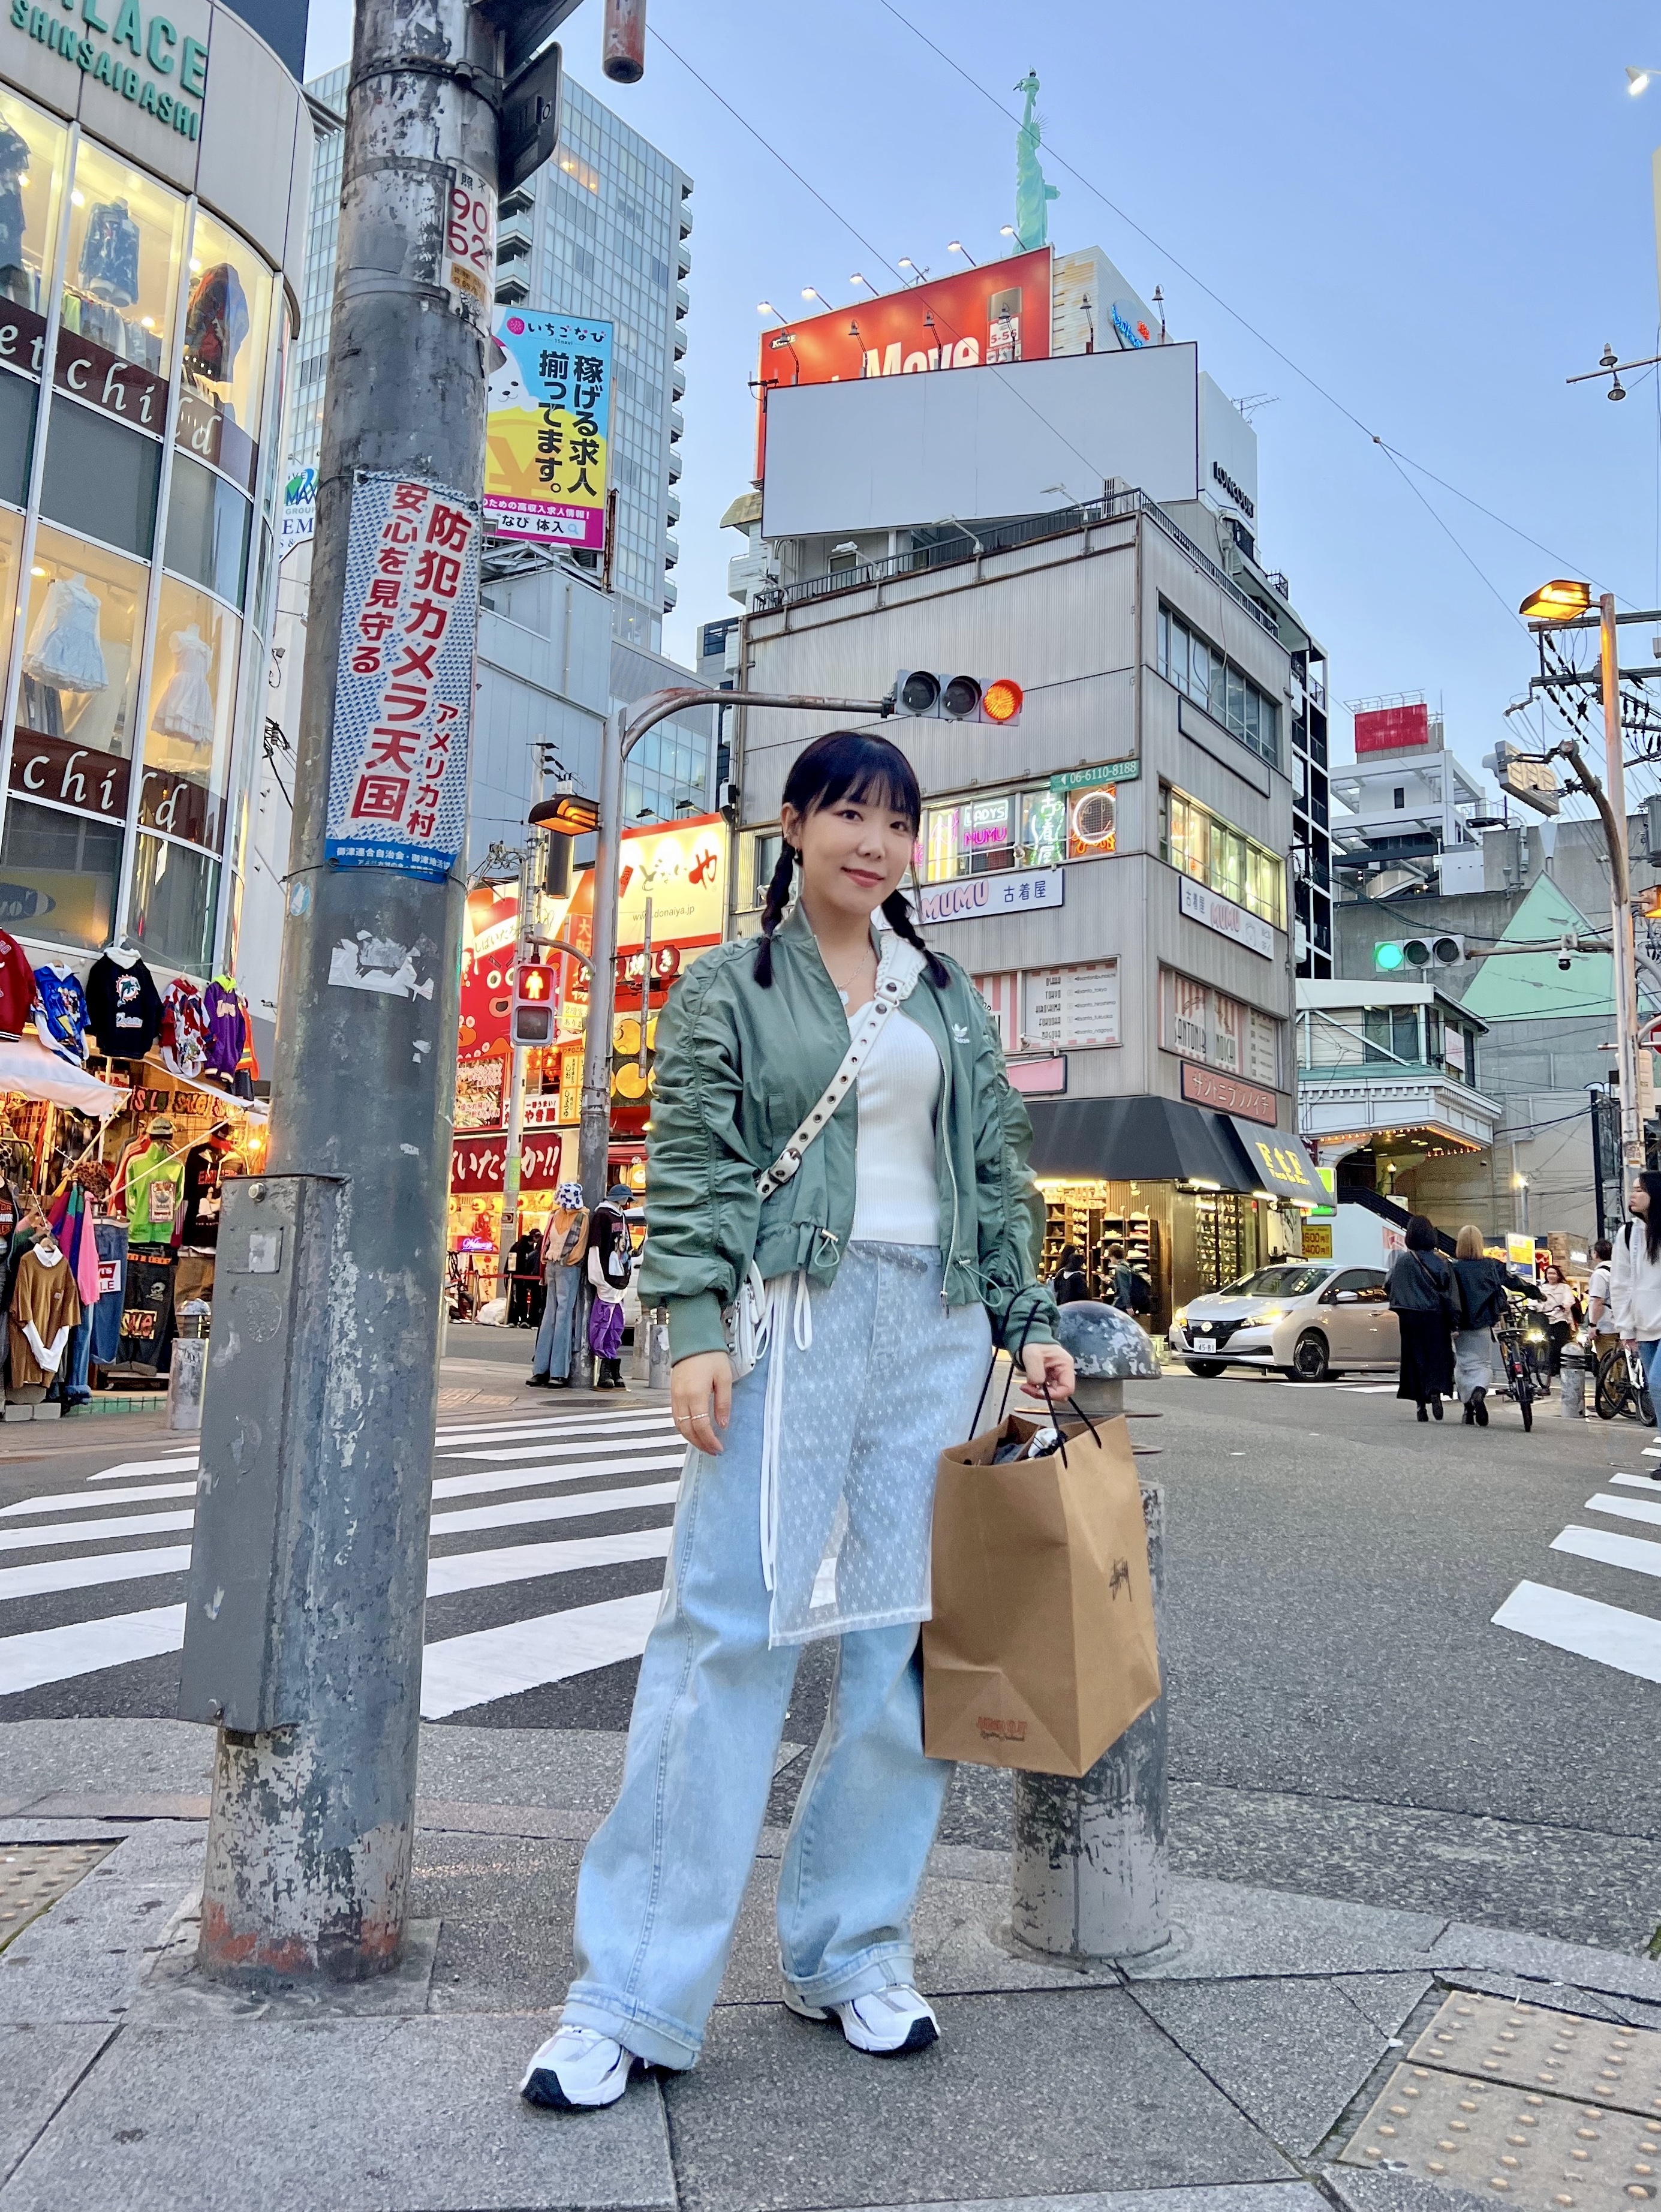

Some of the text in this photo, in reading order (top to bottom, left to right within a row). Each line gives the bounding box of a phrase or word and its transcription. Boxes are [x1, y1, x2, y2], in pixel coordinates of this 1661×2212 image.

[10, 0, 198, 141] SHINSAIBASHI
[62, 0, 208, 98] LACE
[450, 188, 488, 235] 90
[449, 220, 487, 271] 52
[528, 322, 607, 342] いちごなび
[535, 349, 603, 497] 稼げる求人 揃ってます。
[537, 519, 564, 534] 体入
[352, 483, 429, 674] 安心を見守る
[350, 503, 472, 822] 防犯カメラ天国
[406, 703, 459, 838] アメリカ村
[1070, 761, 1137, 784] 06-6110-8188
[965, 805, 1006, 823] LADYS
[633, 904, 695, 921] ww.donaiya.jp
[920, 879, 1046, 924] MUMU 古着屋
[1192, 1070, 1269, 1116] サントニブンノイチ
[1255, 1142, 1304, 1176] FtF
